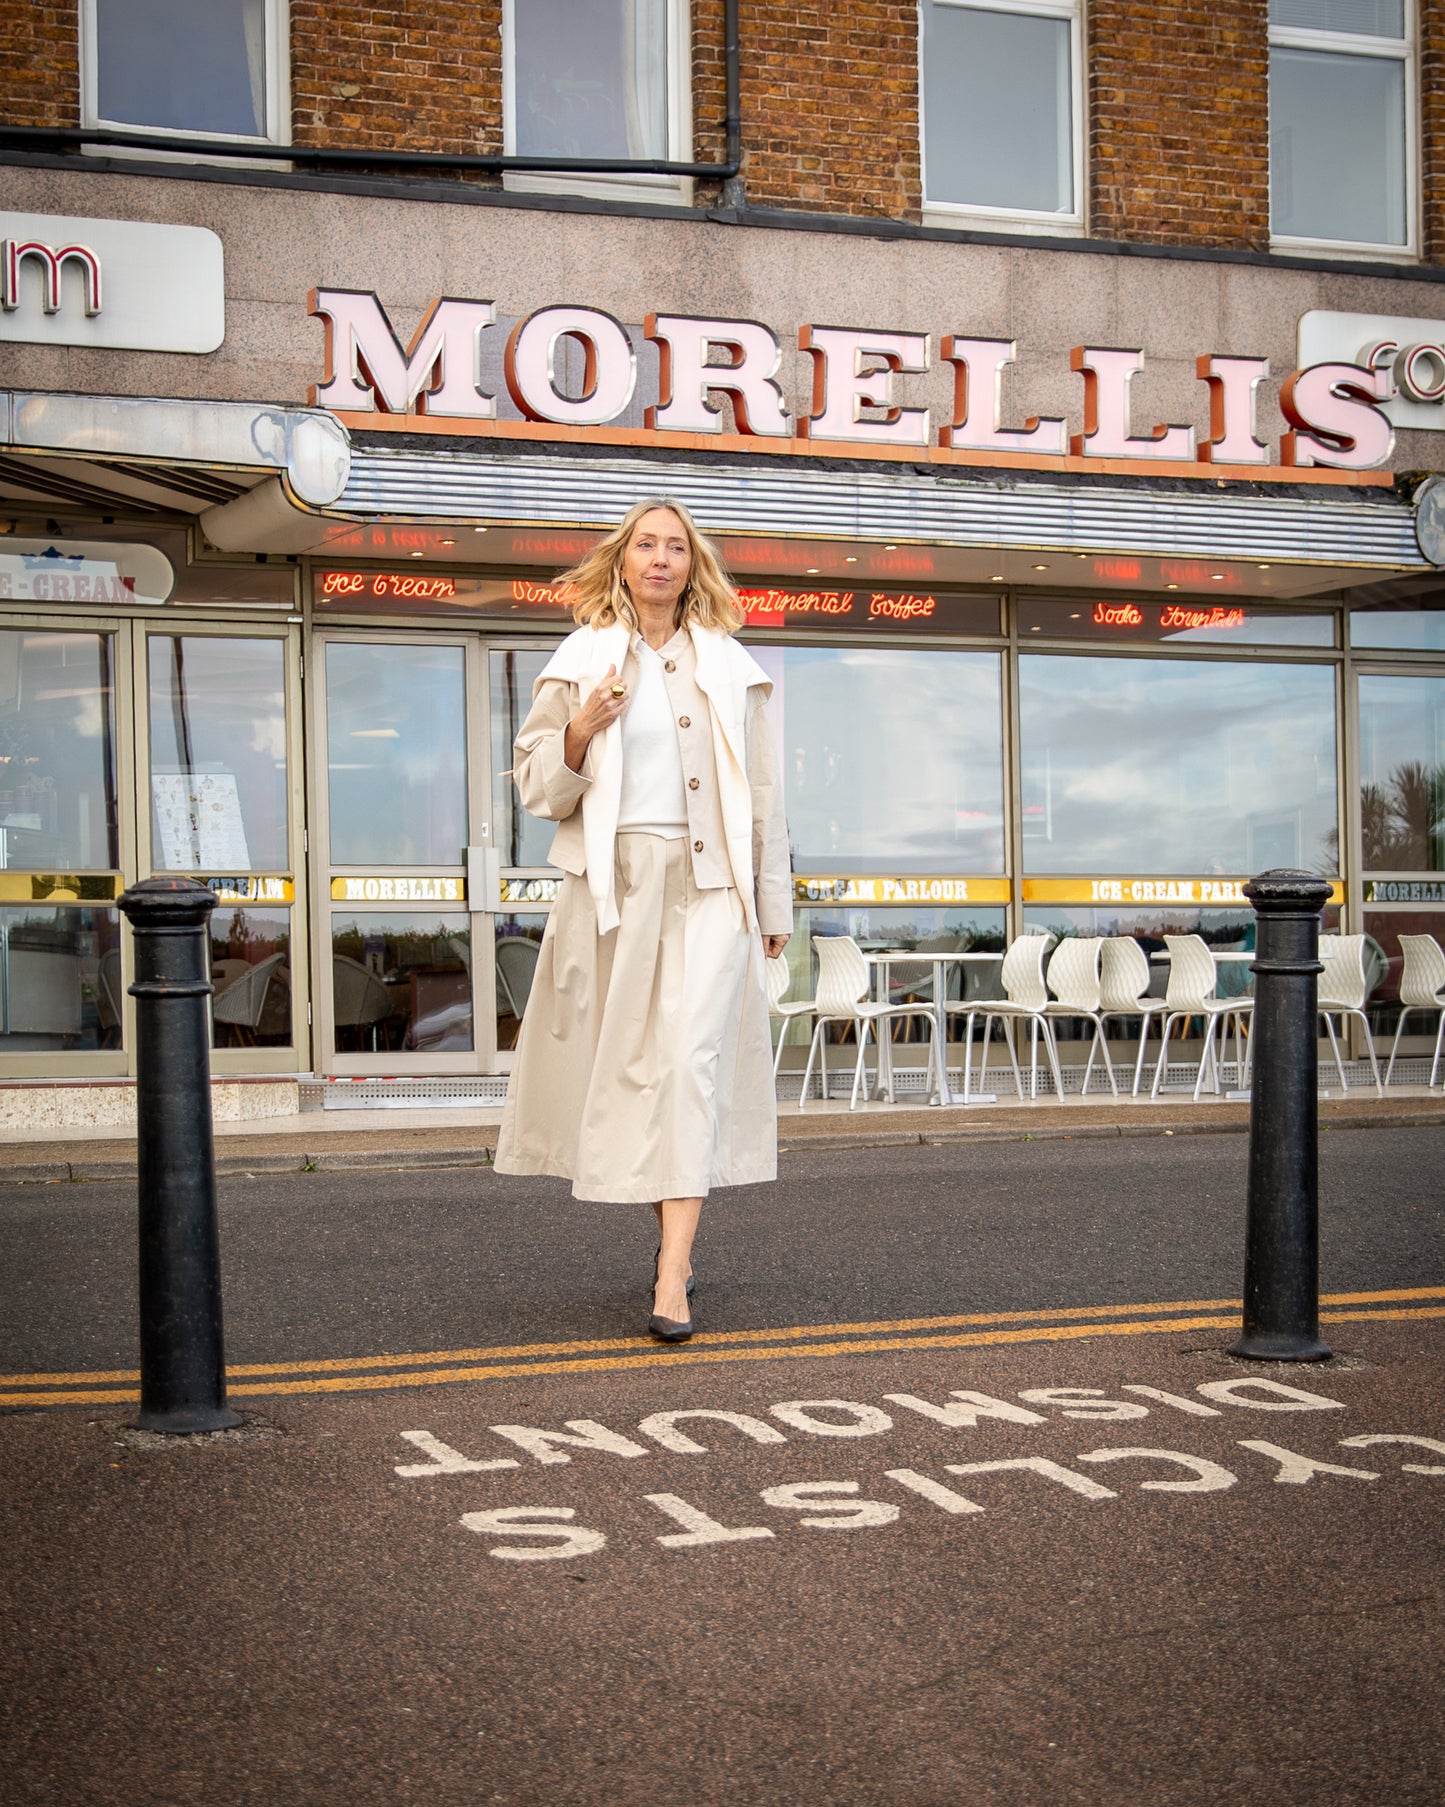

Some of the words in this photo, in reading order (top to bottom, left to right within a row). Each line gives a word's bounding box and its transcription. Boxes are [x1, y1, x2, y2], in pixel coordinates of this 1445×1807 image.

[309, 287, 1396, 470] MORELLIS
[323, 573, 365, 594] Ice
[373, 575, 456, 598] Cream
[870, 592, 936, 620] Coffee
[1093, 602, 1144, 625] Soda
[1160, 605, 1245, 629] Fountain
[345, 877, 458, 900] MORELLI'S
[883, 879, 968, 901] PARLOUR
[1091, 881, 1194, 901] ICE-CREAM
[394, 1377, 1347, 1478] DISMOUNT
